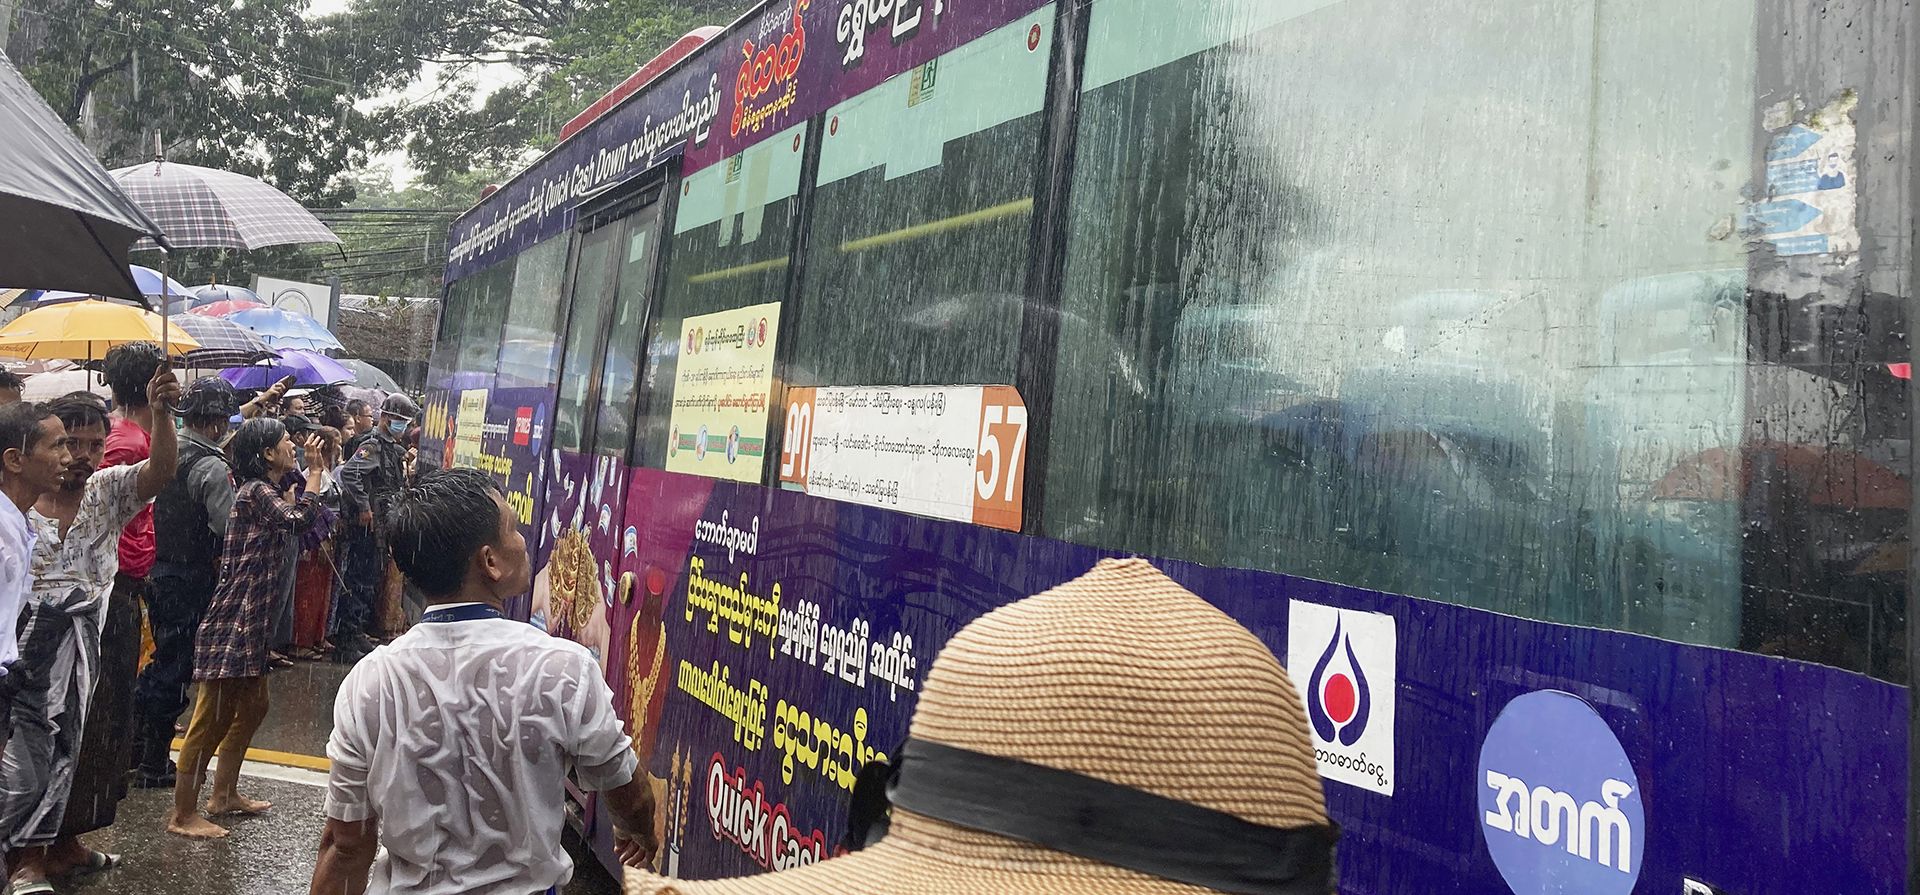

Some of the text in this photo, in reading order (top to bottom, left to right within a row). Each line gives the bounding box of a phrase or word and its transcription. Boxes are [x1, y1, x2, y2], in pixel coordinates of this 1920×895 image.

[544, 170, 571, 217] Quick
[570, 154, 596, 199] Cash
[595, 141, 629, 185] Down
[781, 401, 811, 478] ၅၇
[976, 404, 1028, 502] 57
[695, 508, 760, 565] ဘောက်ချာမပါ
[708, 757, 769, 862] Quick
[1485, 768, 1634, 875] အတက်
